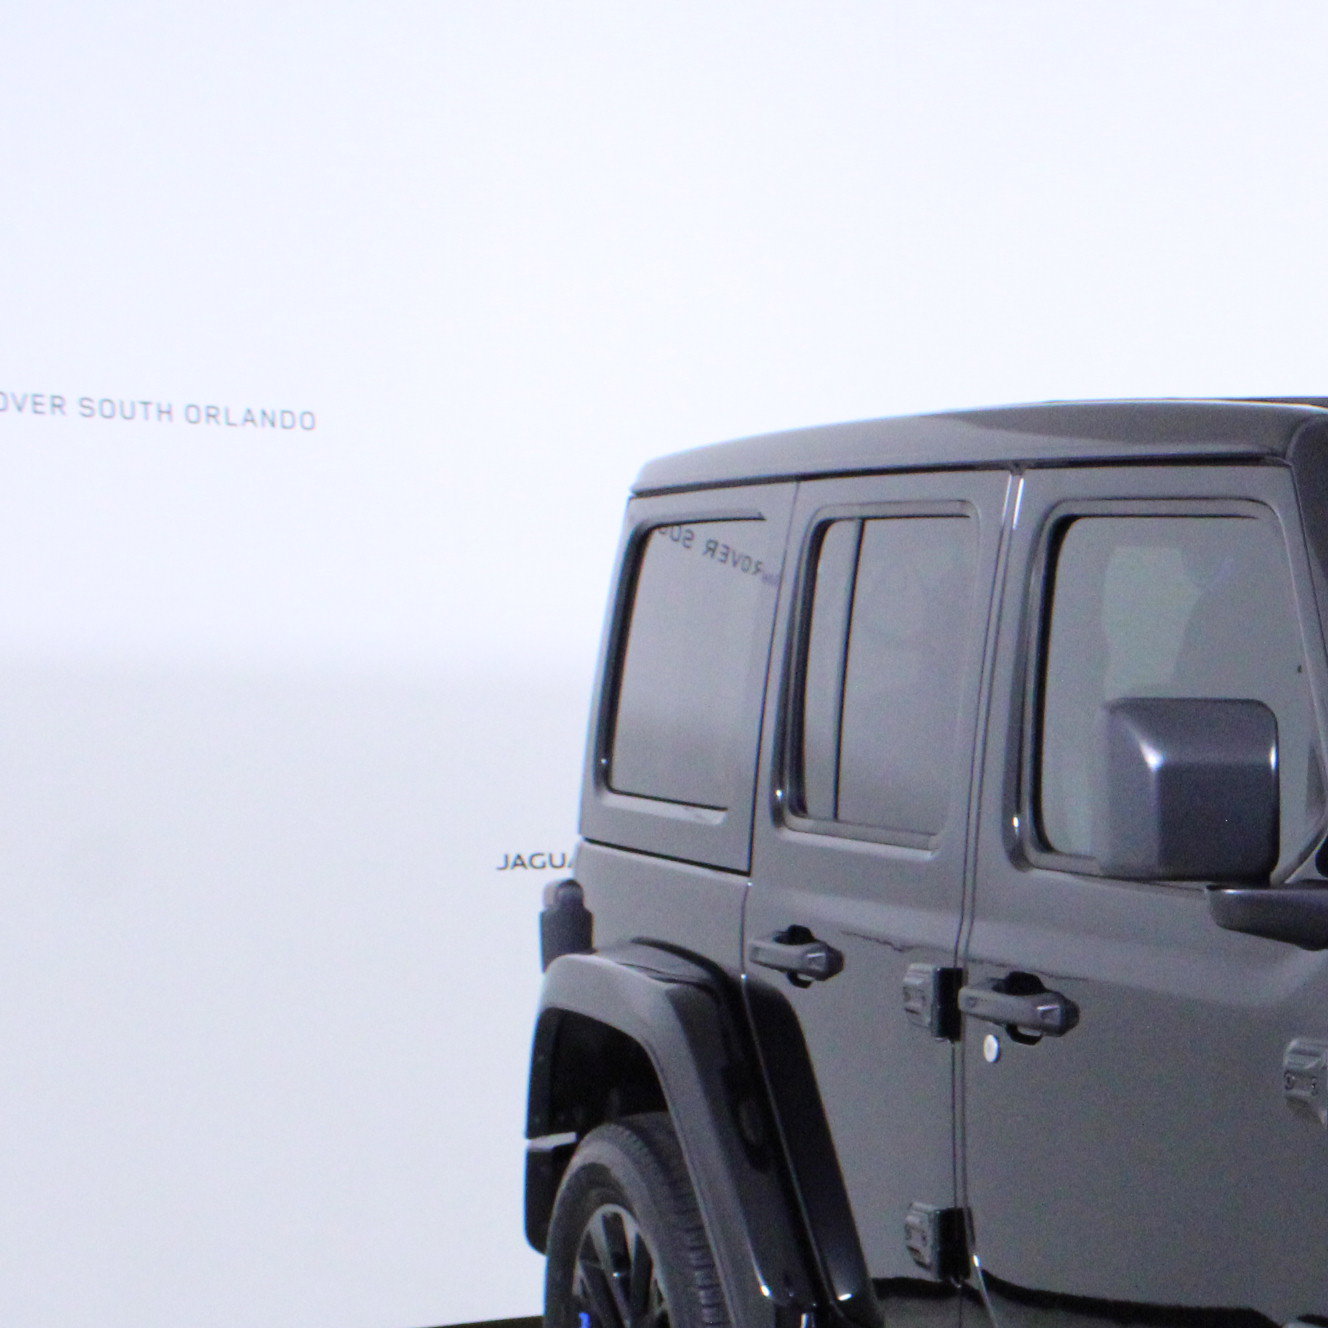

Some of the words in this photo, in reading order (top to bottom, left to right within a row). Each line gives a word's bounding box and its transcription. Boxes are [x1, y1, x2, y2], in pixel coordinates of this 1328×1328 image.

[78, 397, 173, 422] SOUTH
[185, 404, 316, 431] ORLANDO
[497, 852, 574, 870] JAGU
